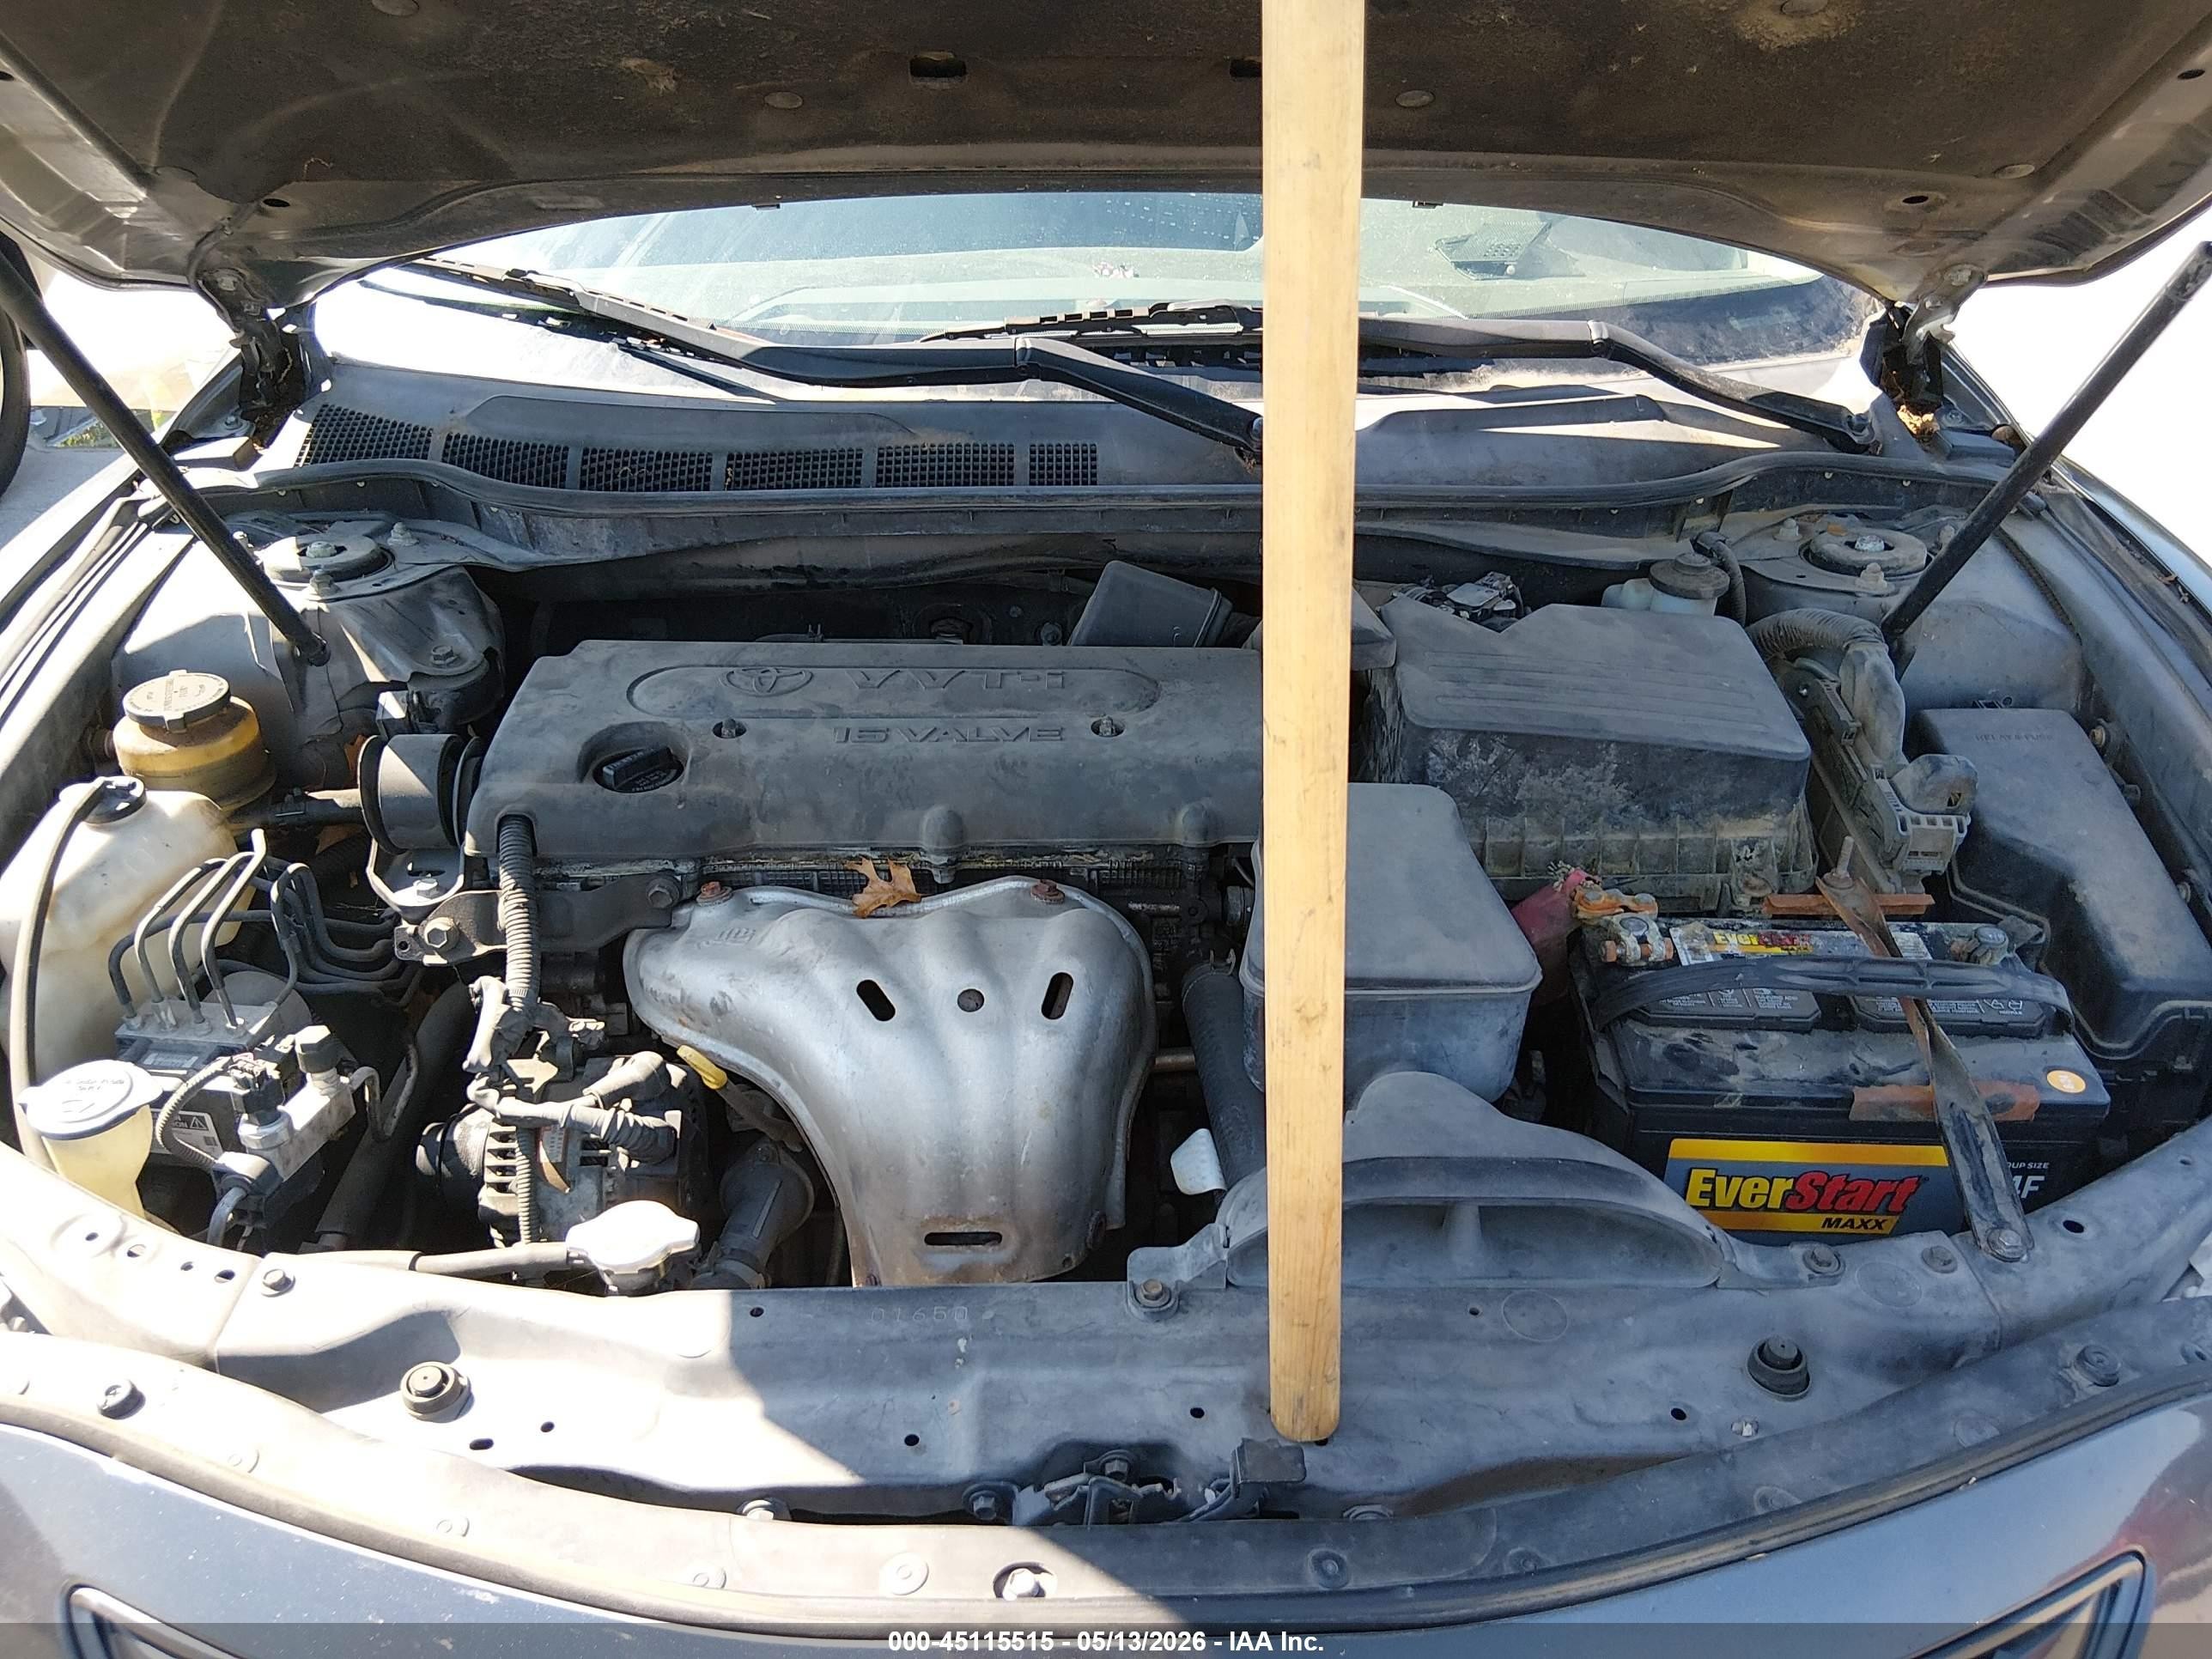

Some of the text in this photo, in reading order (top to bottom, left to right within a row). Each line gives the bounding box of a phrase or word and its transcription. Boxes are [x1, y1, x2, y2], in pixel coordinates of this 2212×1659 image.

[833, 726, 1066, 744] 16 VALVE
[1686, 1167, 1920, 1213] EverStart
[1820, 1216, 1889, 1231] MAXX
